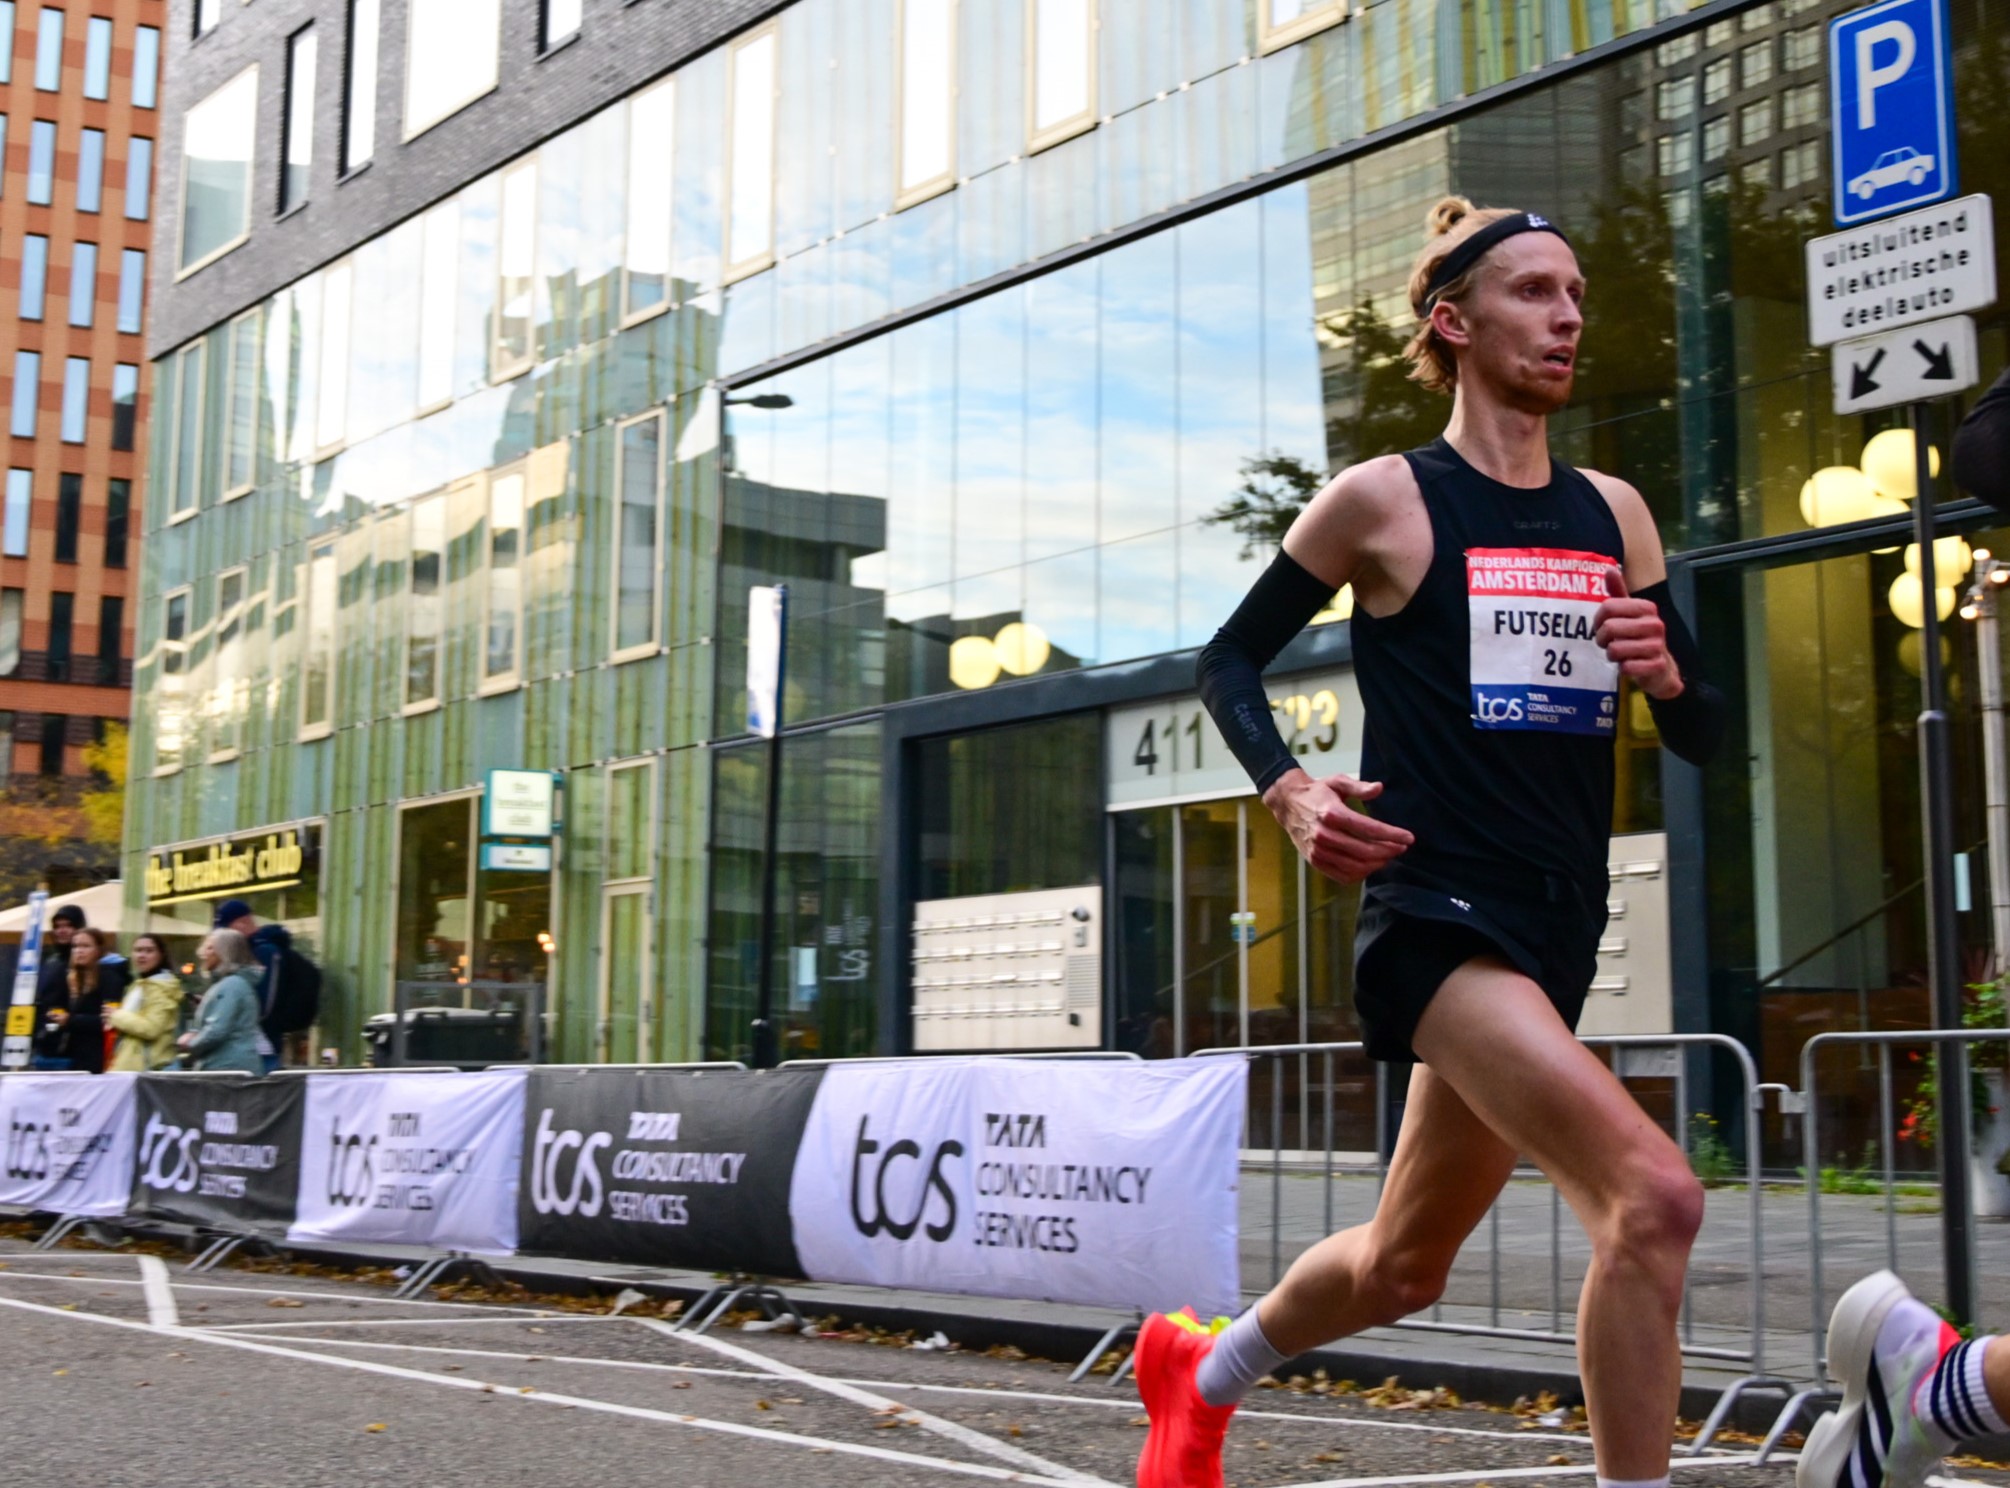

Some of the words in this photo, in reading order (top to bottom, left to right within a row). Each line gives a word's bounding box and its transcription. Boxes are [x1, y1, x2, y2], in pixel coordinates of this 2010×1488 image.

[1855, 20, 1917, 130] P
[1823, 210, 1968, 268] uitsluitend
[1824, 249, 1970, 300] elektrische
[1842, 287, 1954, 328] deelauto
[1469, 556, 1546, 574] NEDERLANDS
[1546, 558, 1608, 575] KAMPIOENS
[1471, 570, 1588, 595] AMSTERDAM
[1544, 648, 1573, 677] 26
[1477, 692, 1524, 721] tcs
[1526, 712, 1560, 724] SERVICES
[1527, 692, 1550, 703] TATA
[1527, 702, 1577, 715] CONSULTANCY
[1134, 711, 1204, 776] 411
[1270, 689, 1339, 754] 23
[144, 856, 173, 896] the
[256, 831, 302, 879] club
[984, 1112, 1047, 1148] TATA
[139, 1111, 201, 1192] tcs
[531, 1108, 613, 1217] tcs
[611, 1149, 747, 1184] CONSULTANCY
[851, 1113, 965, 1243] tcs
[976, 1161, 1153, 1204] CONSULTANCY
[608, 1190, 690, 1225] SERVICES
[973, 1210, 1079, 1253] SERVICES
